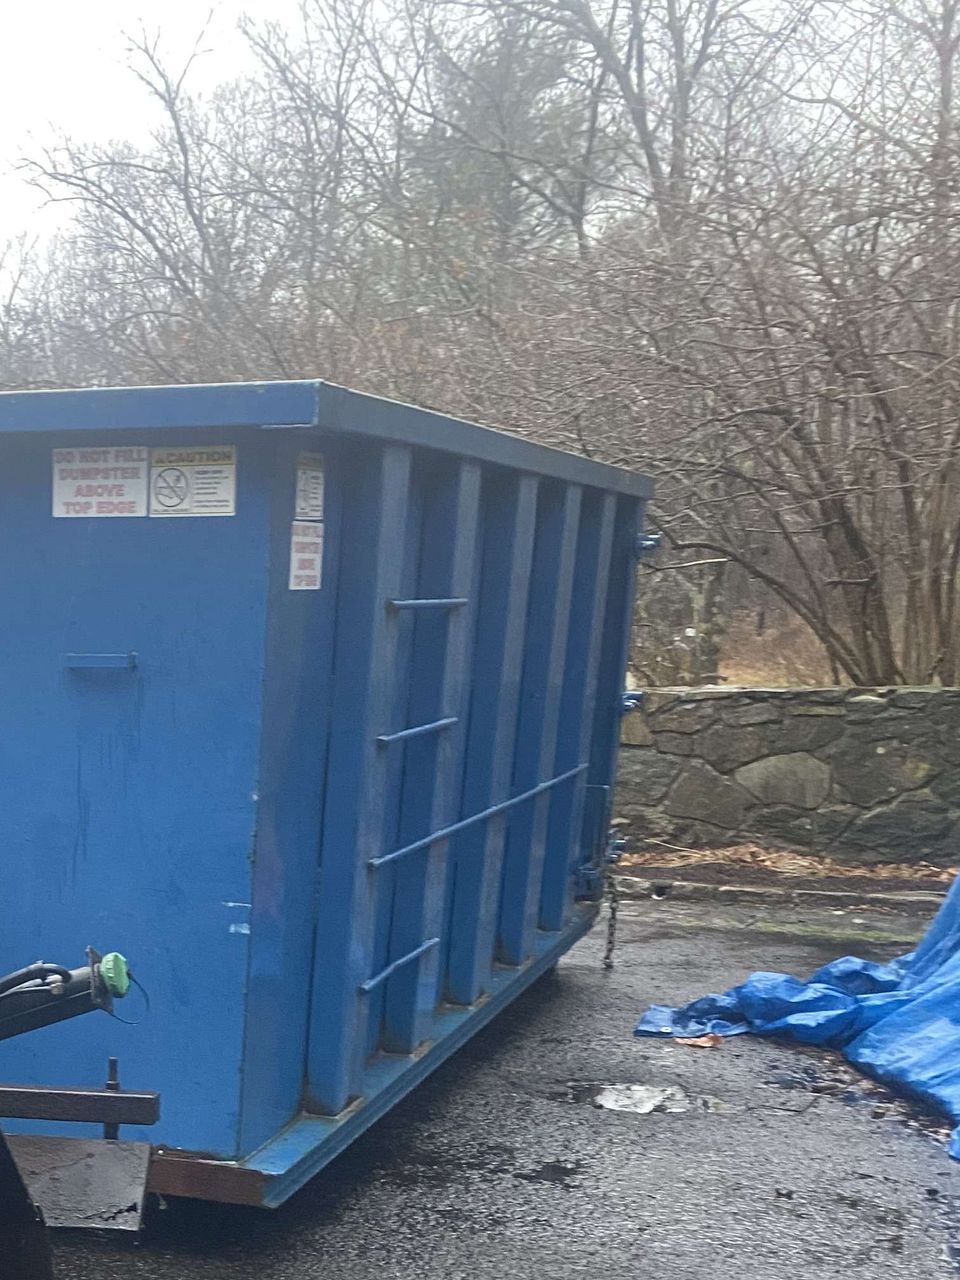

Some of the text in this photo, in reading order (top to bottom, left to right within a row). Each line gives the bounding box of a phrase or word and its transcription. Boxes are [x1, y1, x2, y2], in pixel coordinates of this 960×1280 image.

[114, 448, 146, 462] FILL
[167, 451, 233, 463] CAUTION
[58, 467, 140, 480] DUMPSTER
[74, 484, 125, 498] ABOVE
[63, 501, 136, 514] TOP EDGE
